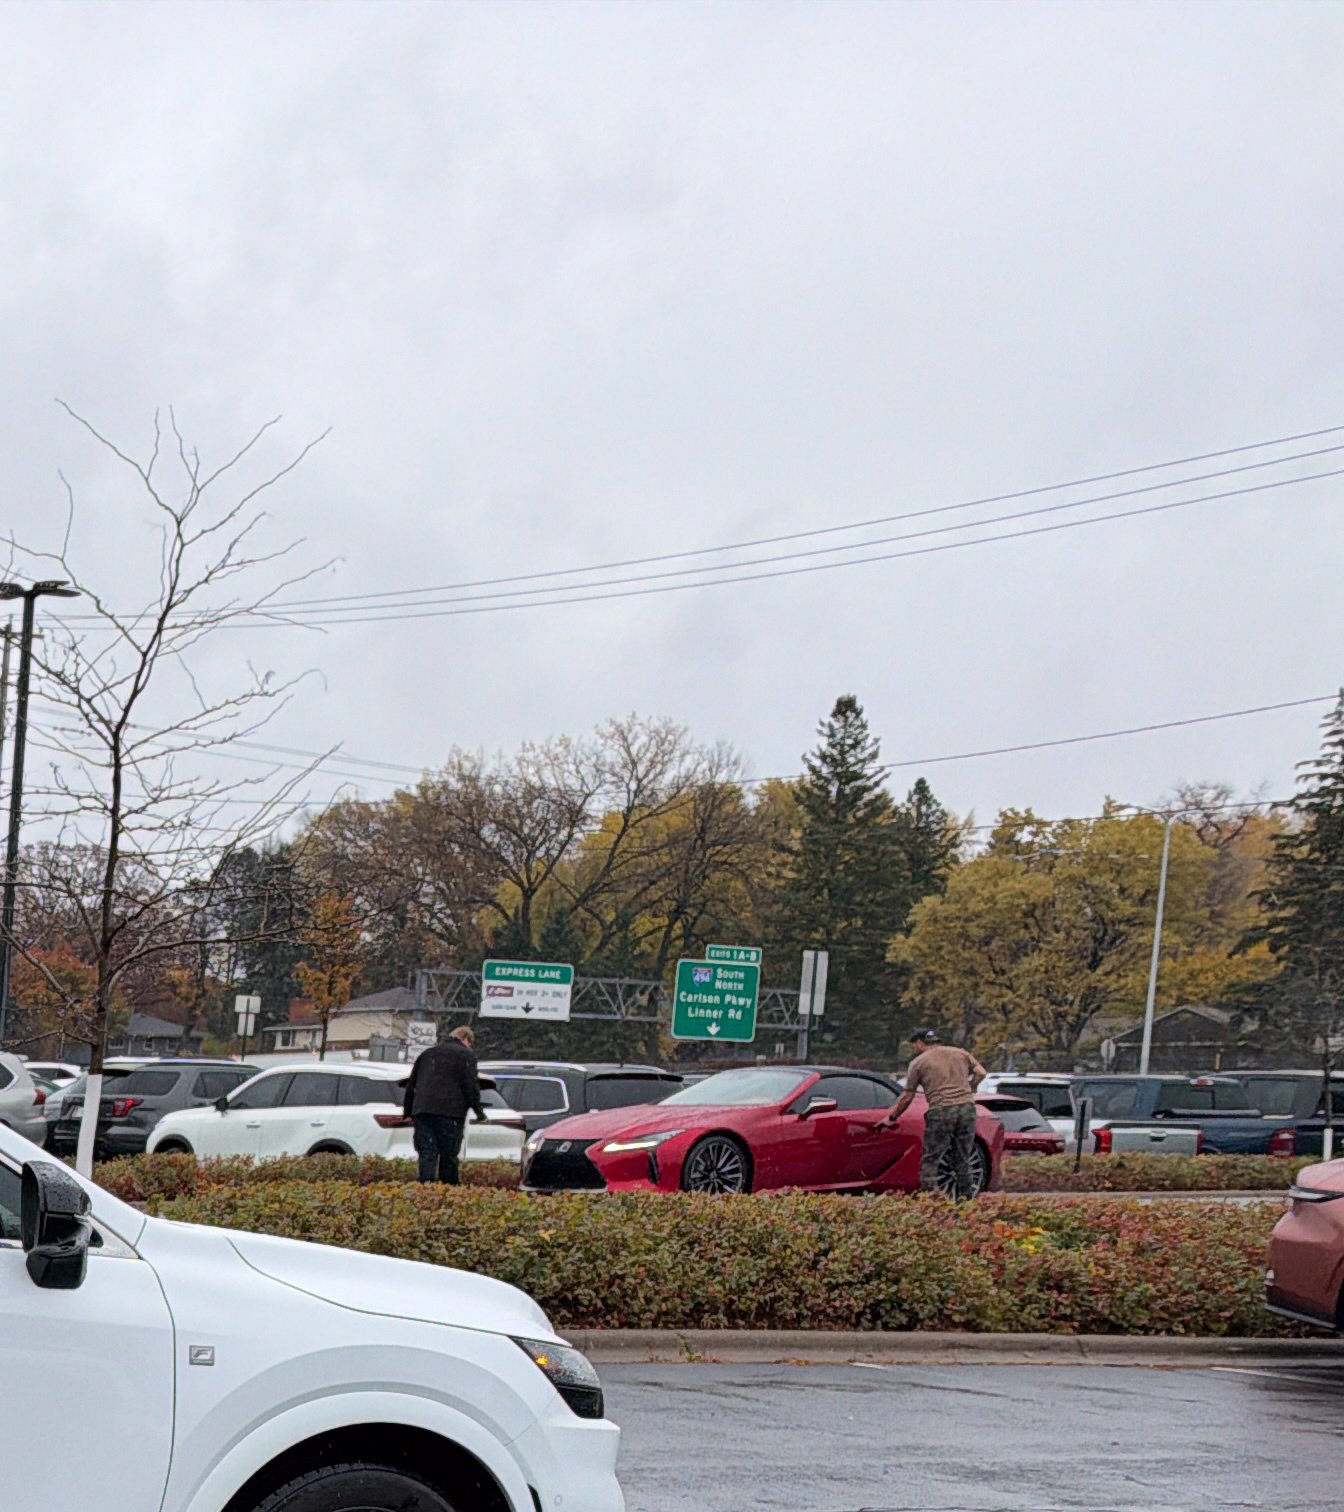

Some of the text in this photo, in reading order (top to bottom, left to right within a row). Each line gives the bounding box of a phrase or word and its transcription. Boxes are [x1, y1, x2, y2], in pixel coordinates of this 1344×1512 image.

[495, 966, 561, 980] EXPRESS LANE
[679, 990, 753, 1009] Carlson Pkwy
[687, 1006, 743, 1020] Linner Rd
